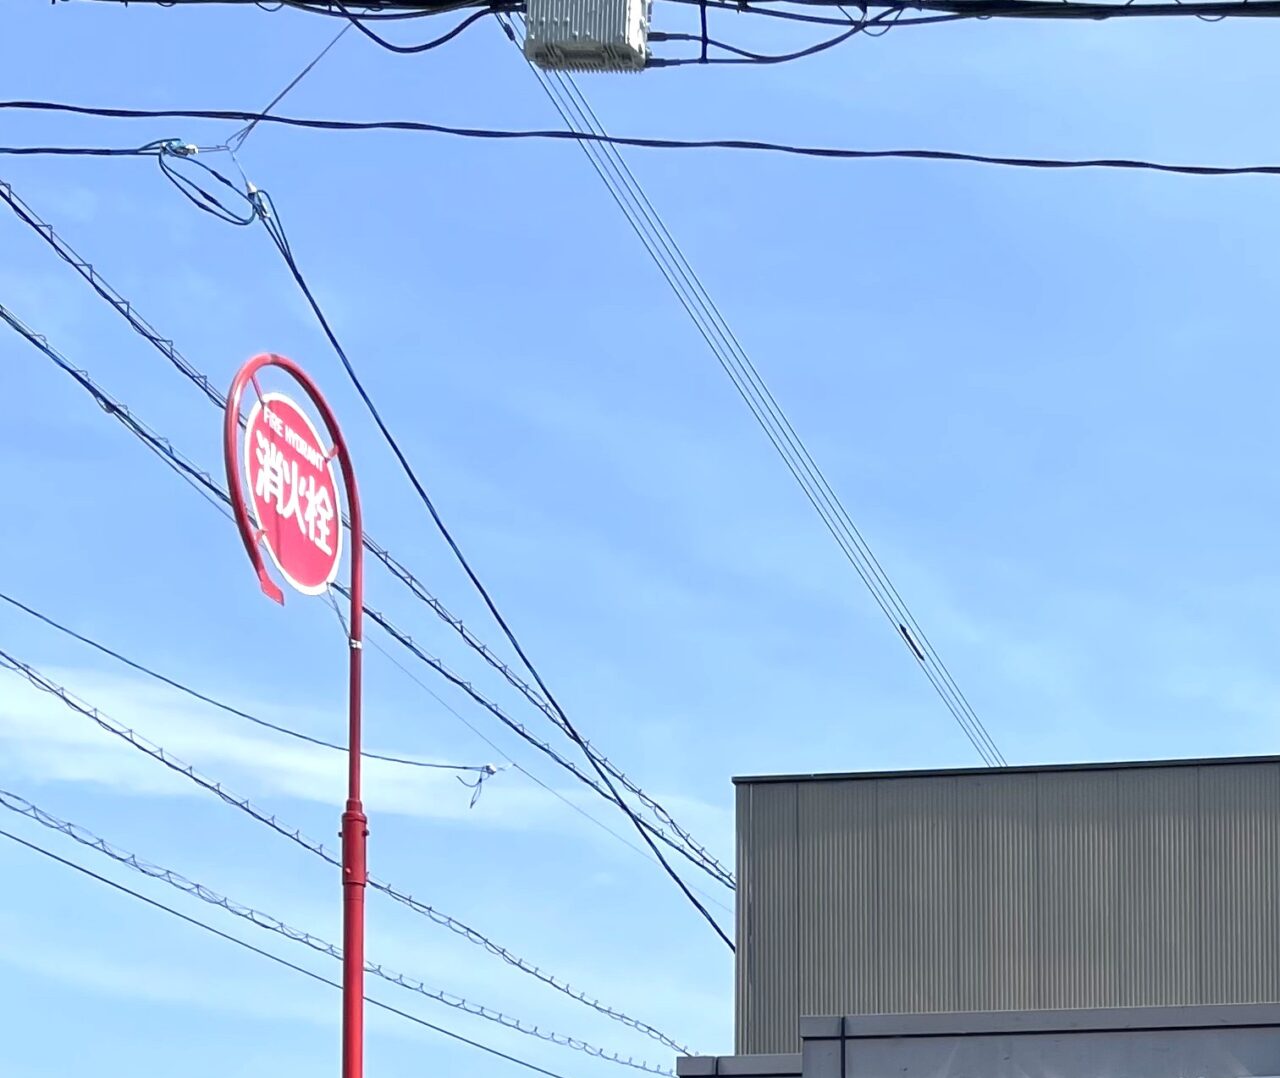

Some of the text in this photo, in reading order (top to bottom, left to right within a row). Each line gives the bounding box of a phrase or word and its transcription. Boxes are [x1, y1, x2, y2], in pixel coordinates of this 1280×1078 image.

[263, 406, 325, 473] FIRE HYDRANT
[255, 429, 333, 556] 消火栓
